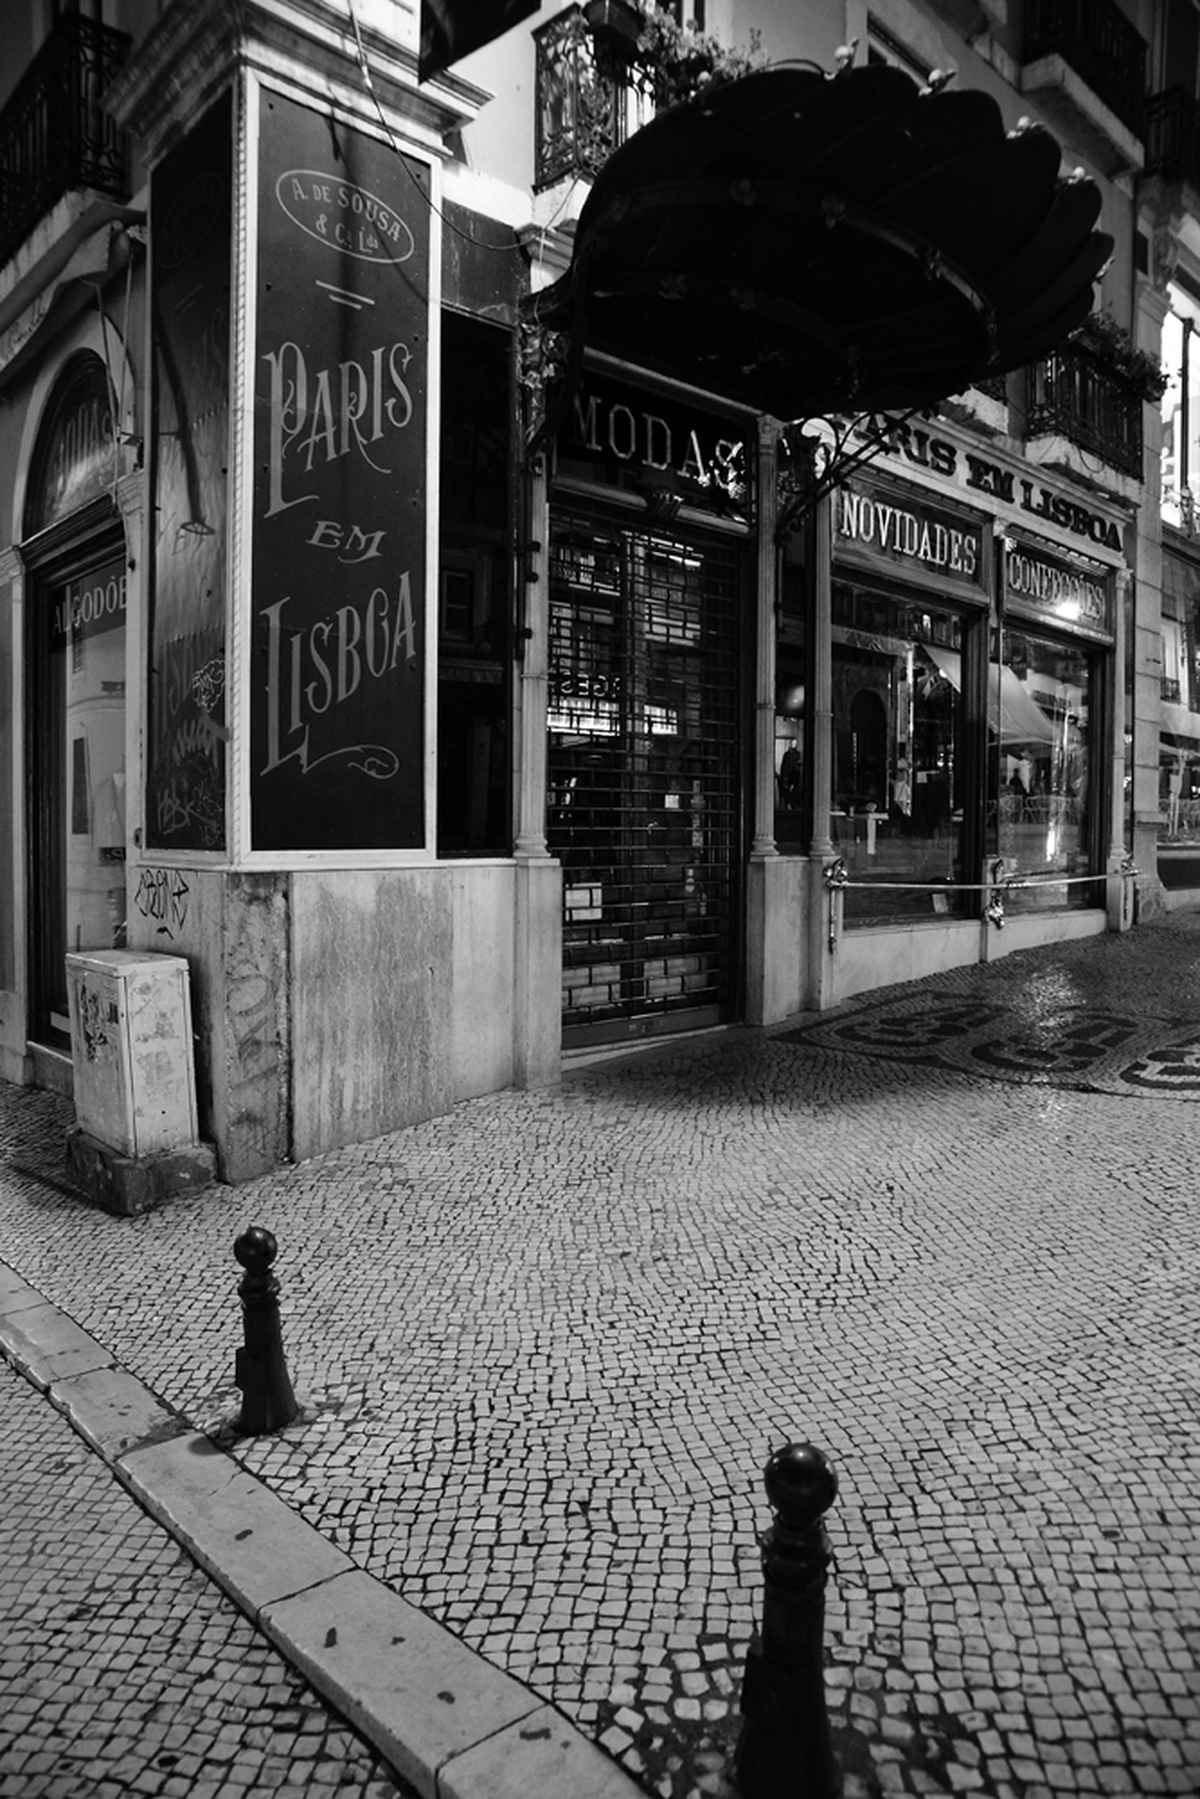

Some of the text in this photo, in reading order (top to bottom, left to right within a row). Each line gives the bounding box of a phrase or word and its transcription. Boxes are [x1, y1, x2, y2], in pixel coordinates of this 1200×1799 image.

[312, 184, 332, 203] DE
[337, 186, 402, 243] SOUSA
[315, 213, 329, 237] &
[261, 342, 414, 519] PARIS
[305, 520, 387, 564] EM
[840, 490, 977, 576] NOVIDADES
[965, 454, 1015, 503] EM
[1020, 480, 1123, 553] LISBOA
[260, 570, 417, 780] LISBOA
